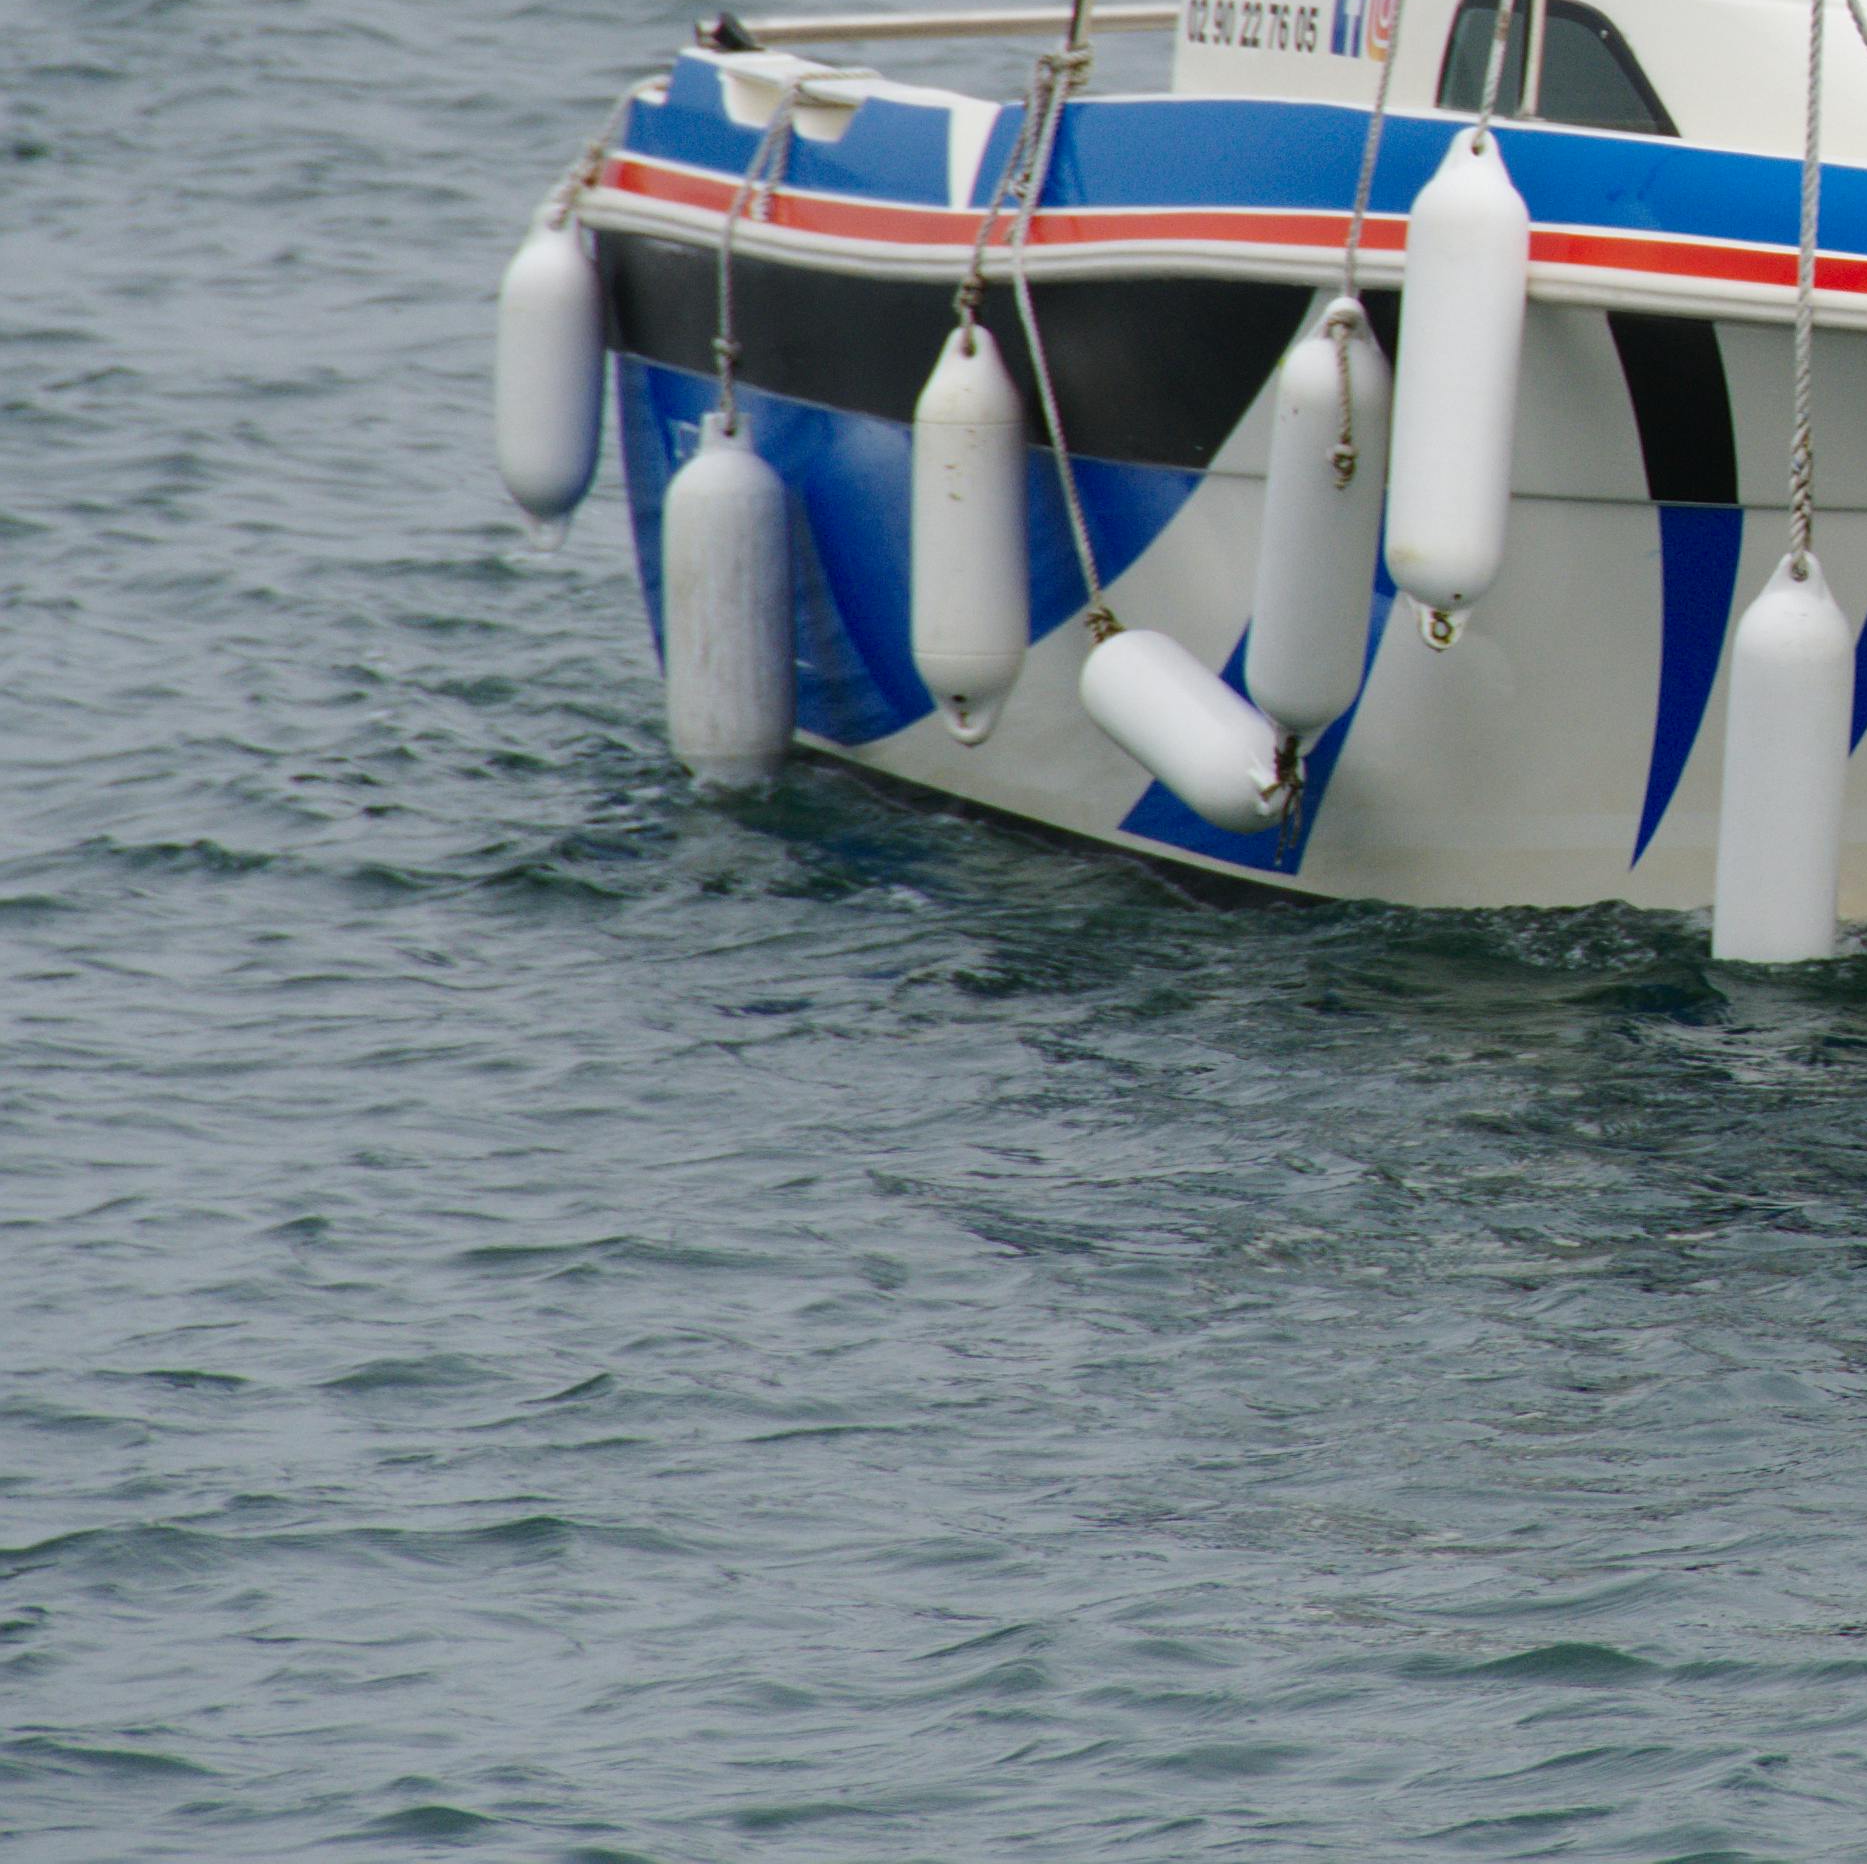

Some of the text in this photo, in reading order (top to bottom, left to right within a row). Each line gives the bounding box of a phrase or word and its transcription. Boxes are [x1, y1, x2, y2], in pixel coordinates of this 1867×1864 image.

[1239, 0, 1263, 49] 22
[1266, 3, 1290, 51] 76
[1294, 6, 1318, 54] 05
